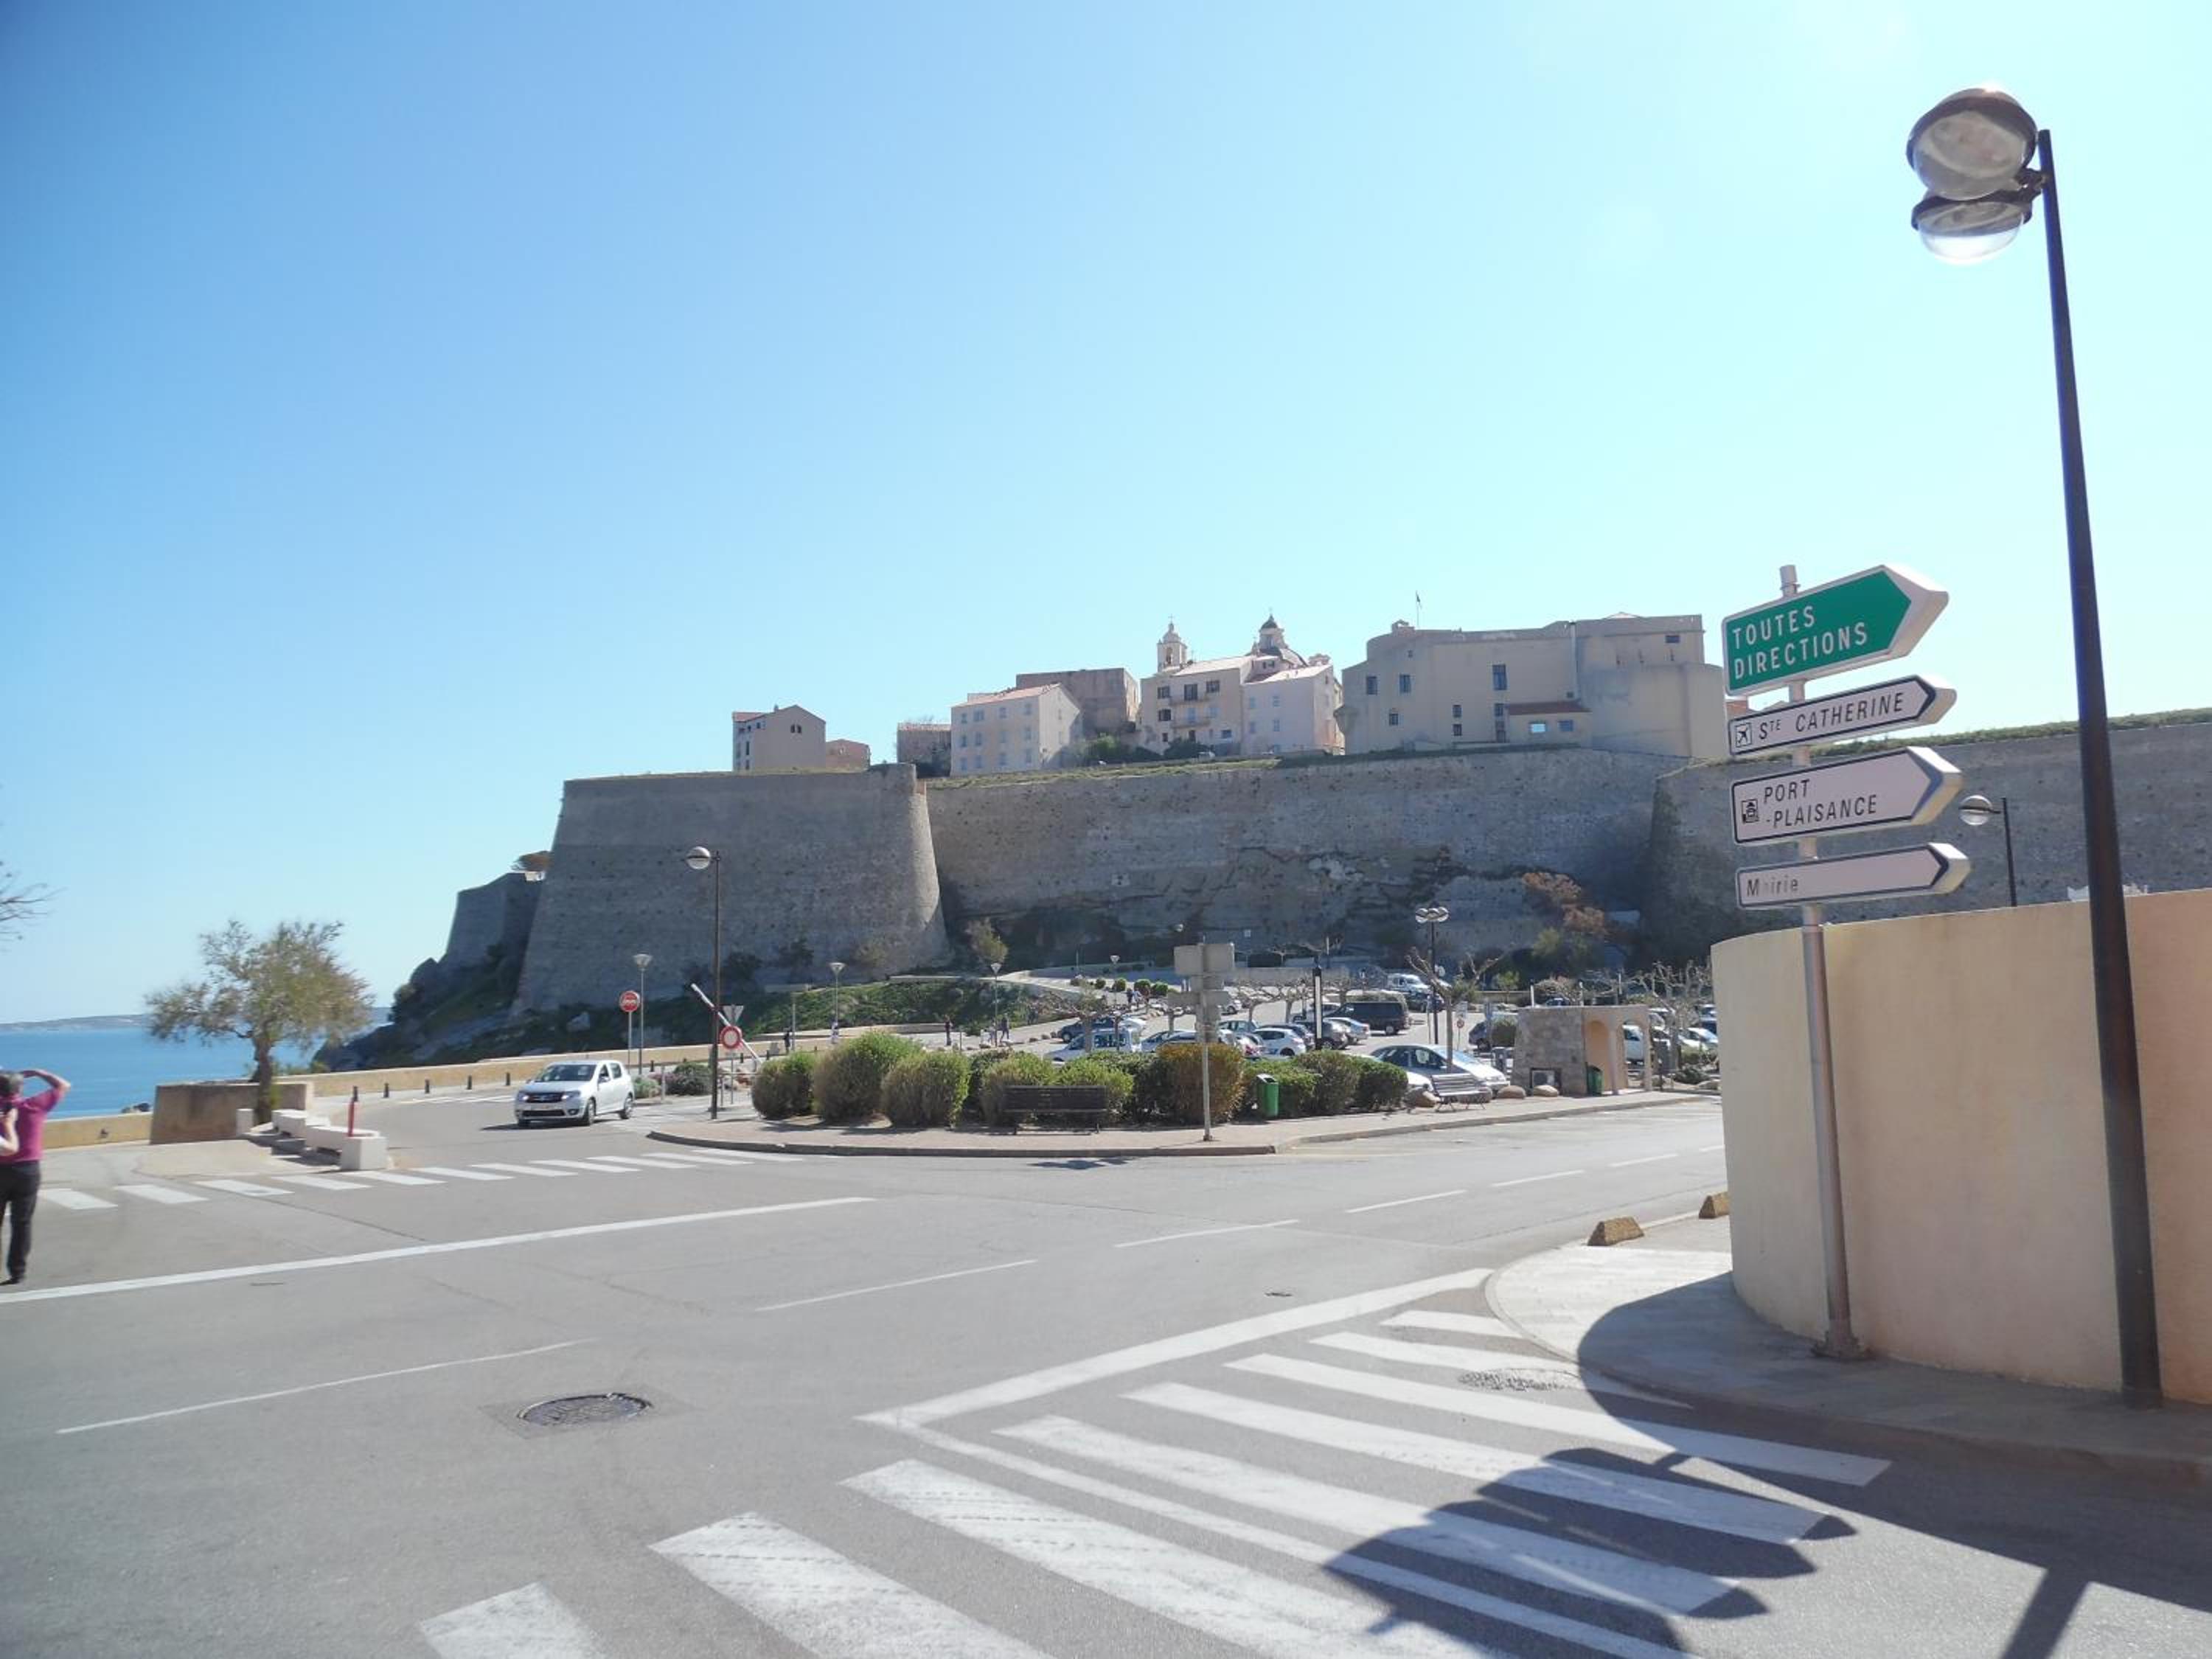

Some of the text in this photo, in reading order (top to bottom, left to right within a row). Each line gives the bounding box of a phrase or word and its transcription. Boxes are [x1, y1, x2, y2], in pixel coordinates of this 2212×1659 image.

[1733, 605, 1815, 650] TOUTES
[1734, 622, 1868, 680] DIRECTIONS
[1795, 692, 1905, 732] CATHERINE
[1763, 778, 1810, 804] PORT
[1747, 874, 1798, 897] Mirie
